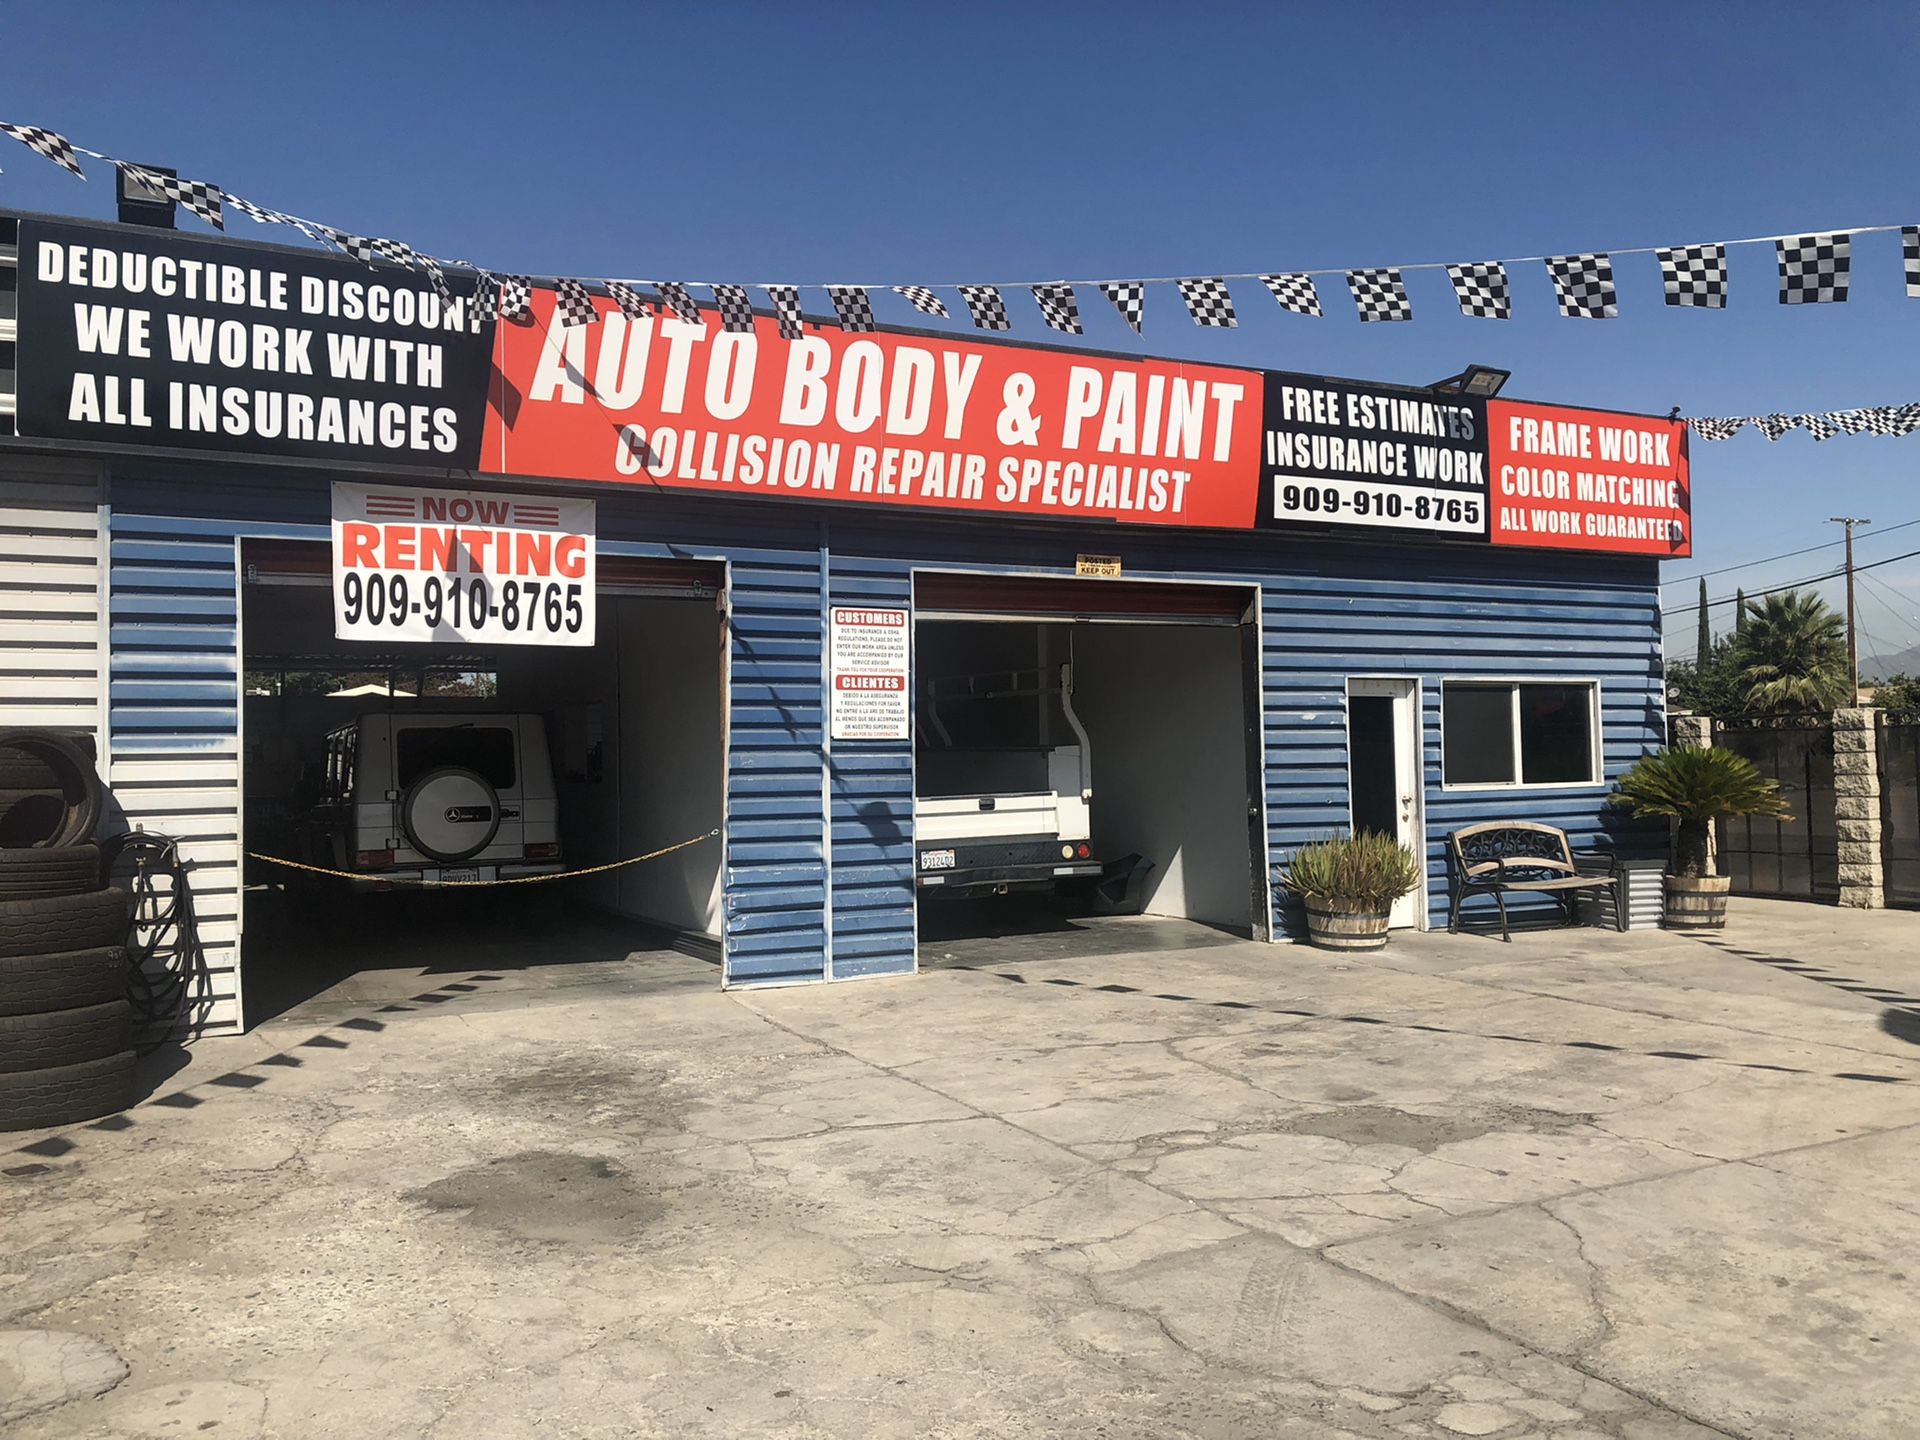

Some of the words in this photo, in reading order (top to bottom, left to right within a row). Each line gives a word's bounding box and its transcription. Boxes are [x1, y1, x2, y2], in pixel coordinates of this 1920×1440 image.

[38, 241, 288, 310] DEDUCTIBLE
[301, 276, 496, 334] DISCOUNT
[74, 302, 151, 358] WE
[167, 313, 313, 376] WORK
[327, 332, 443, 388] WITH
[528, 304, 758, 420] AUTO
[778, 334, 983, 440] BODY
[996, 372, 1041, 446] &
[1061, 366, 1244, 462] PAINT
[68, 372, 152, 427] ALL
[169, 382, 457, 453] INSURANCES
[1282, 386, 1340, 425] FREE
[1346, 393, 1475, 440] ESTIMATES
[1266, 431, 1408, 476] INSURANCE
[1414, 445, 1484, 484] WORK
[1509, 416, 1592, 459] FRAME
[1598, 426, 1671, 466] WORK
[614, 424, 840, 490] COLLISION
[850, 446, 986, 500] REPAIR
[995, 456, 1192, 513] SPECIALIST
[1501, 465, 1570, 500] COLOR
[1576, 472, 1679, 508] MATCHING
[422, 496, 510, 524] NOW
[1283, 485, 1479, 524] 909-910-8765
[1500, 507, 1527, 531] ALL
[1531, 509, 1582, 534] WORK
[342, 522, 586, 578] RENTING
[344, 572, 582, 633] 909-910-8765
[837, 612, 902, 625] CUSTOMERS
[842, 676, 898, 689] CLIENTES
